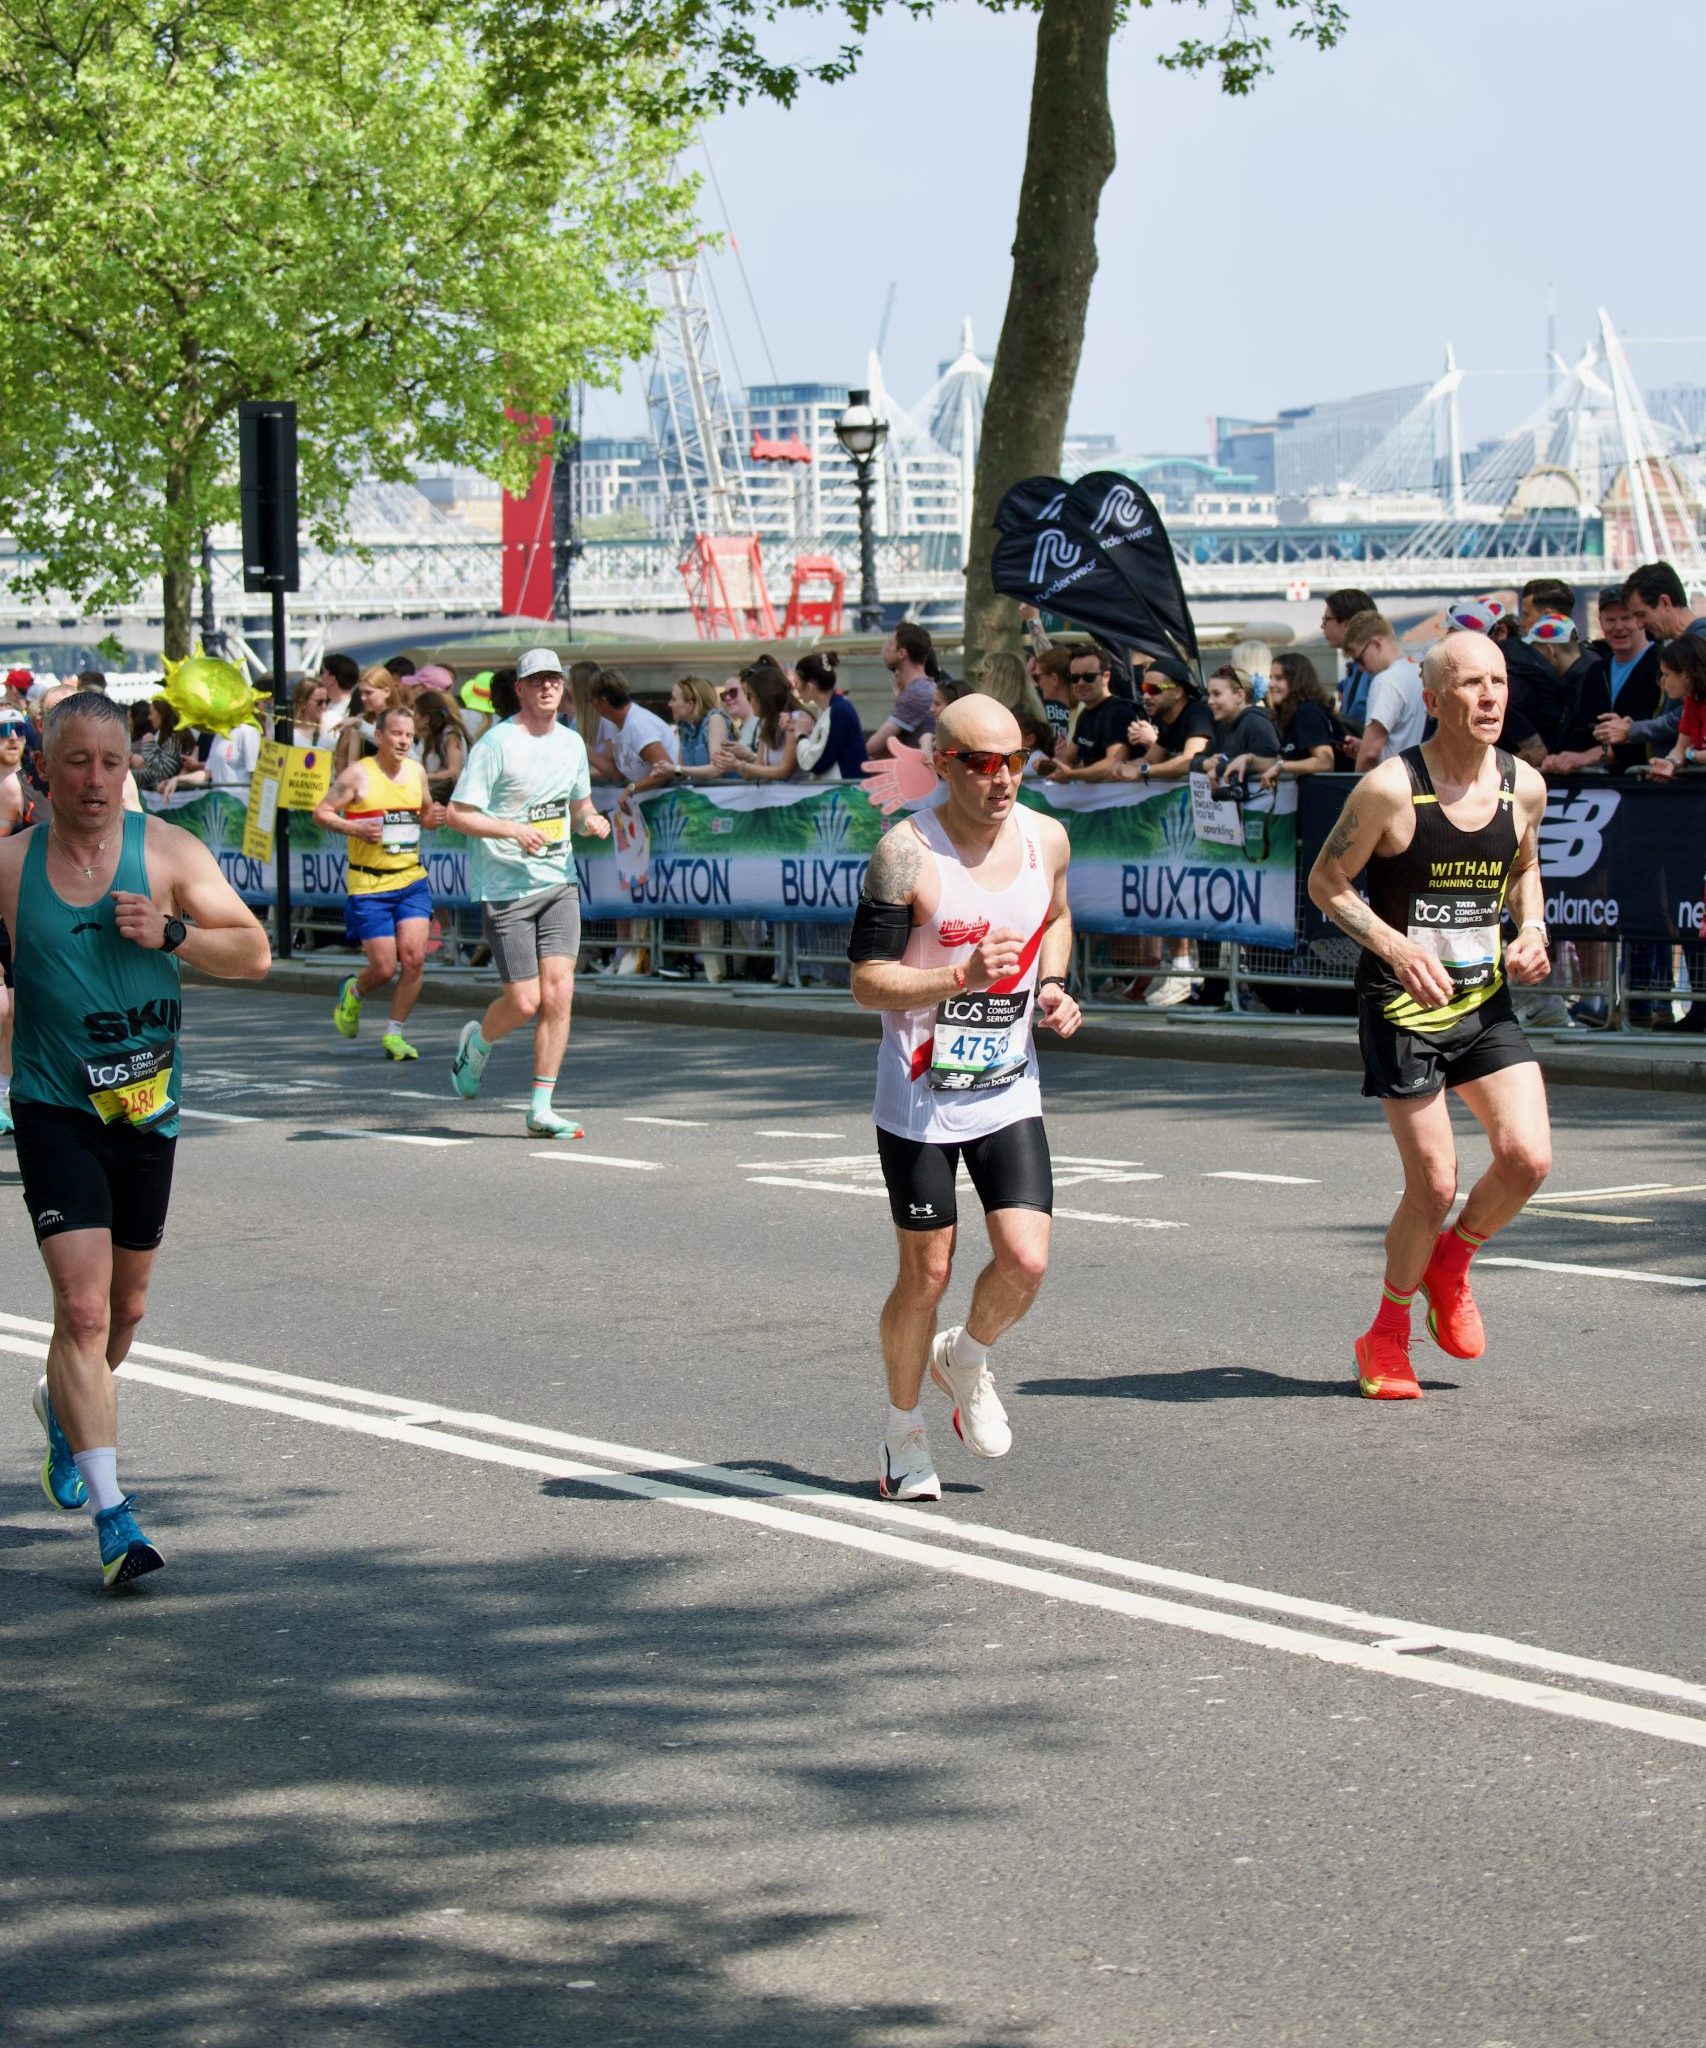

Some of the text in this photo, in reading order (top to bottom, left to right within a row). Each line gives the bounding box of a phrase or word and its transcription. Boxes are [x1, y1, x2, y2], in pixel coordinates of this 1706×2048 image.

[1100, 526, 1153, 549] nderwear
[1035, 558, 1097, 602] runderwear
[289, 779, 323, 792] WARNING
[302, 853, 348, 894] BUX
[1431, 861, 1503, 877] WITHAM
[1122, 864, 1262, 925] BUXTON
[1429, 879, 1499, 888] RUNNING CLUB
[1454, 915, 1483, 924] SERVICES
[1545, 891, 1619, 926] alance
[1678, 901, 1705, 929] ne
[944, 997, 983, 1021] tcs
[130, 1051, 153, 1062] TATA
[87, 1063, 129, 1087] tcs
